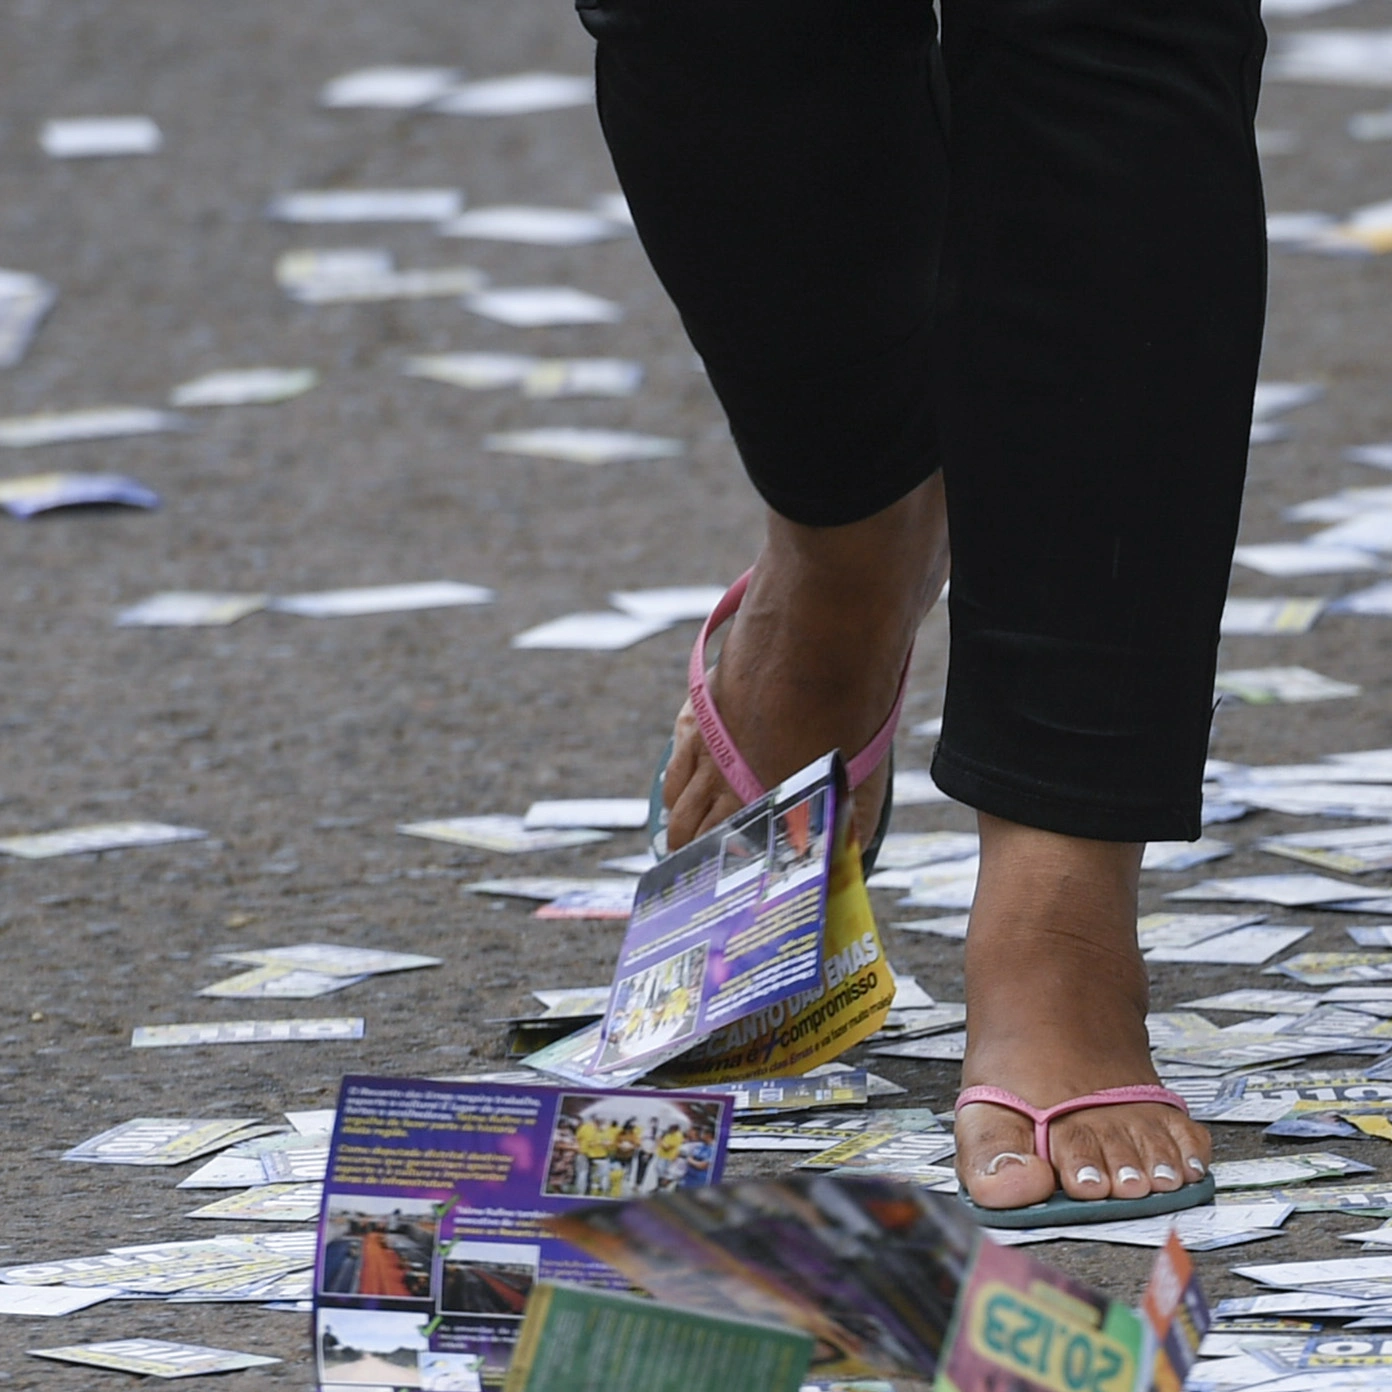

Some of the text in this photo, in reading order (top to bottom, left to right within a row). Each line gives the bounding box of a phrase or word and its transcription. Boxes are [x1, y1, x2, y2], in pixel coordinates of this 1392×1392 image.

[691, 684, 736, 769] havaianas
[826, 932, 880, 988] EMAS
[779, 972, 878, 1049] compromisso
[96, 1125, 191, 1154] 1110
